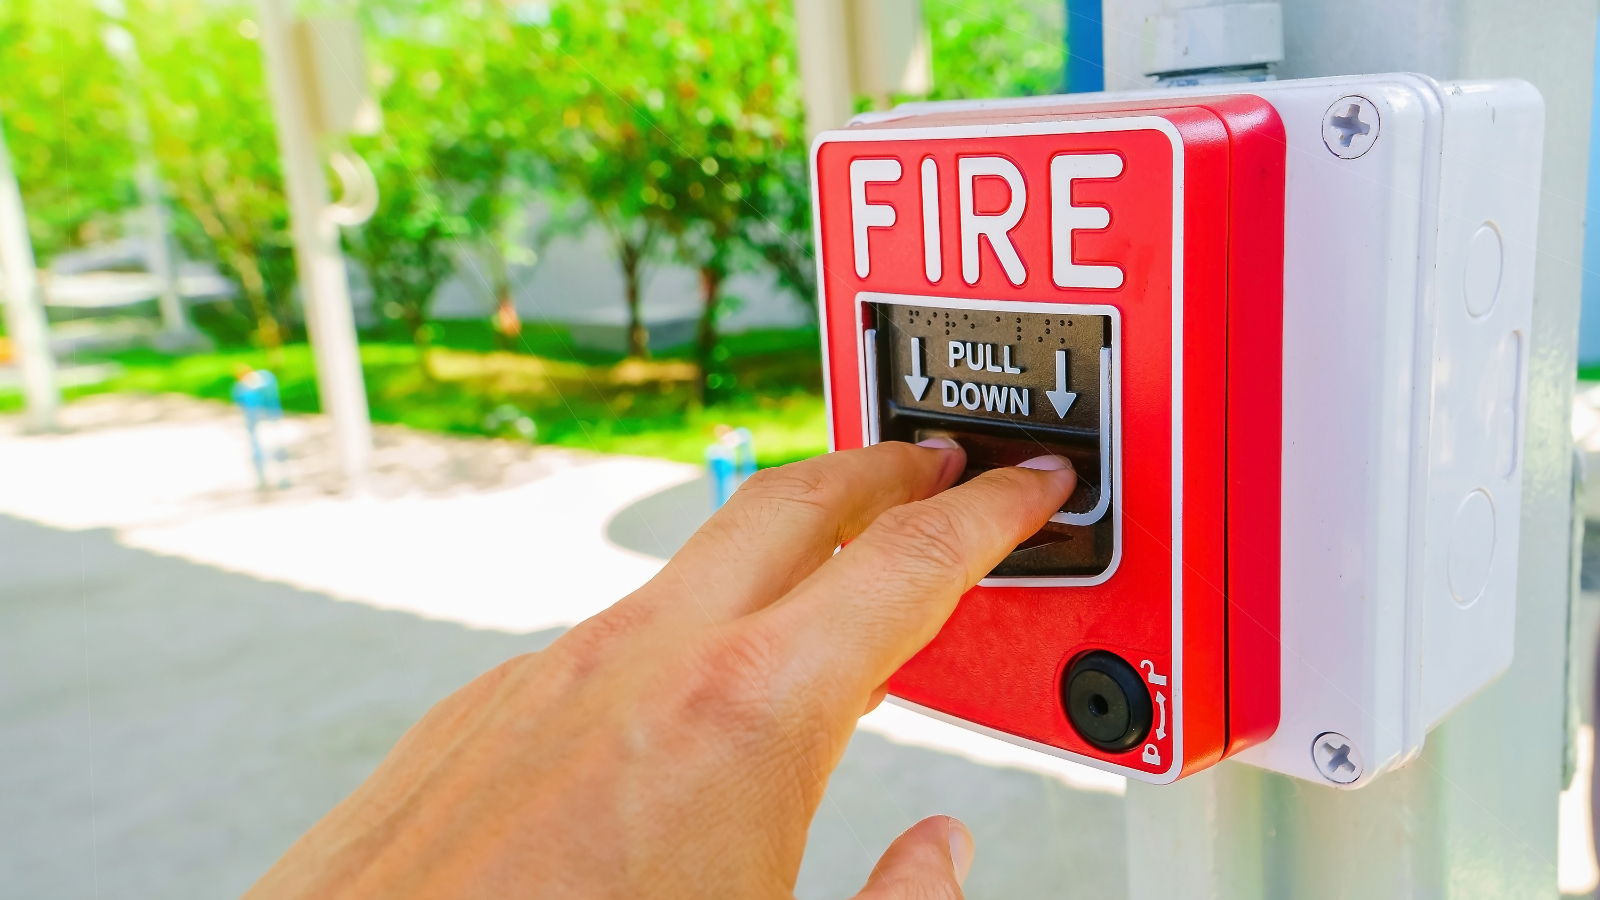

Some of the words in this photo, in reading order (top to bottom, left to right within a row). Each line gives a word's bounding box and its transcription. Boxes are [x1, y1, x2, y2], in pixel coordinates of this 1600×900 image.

[849, 153, 1125, 289] FIRE
[948, 340, 1021, 375] PULL
[941, 379, 1029, 416] DOWN
